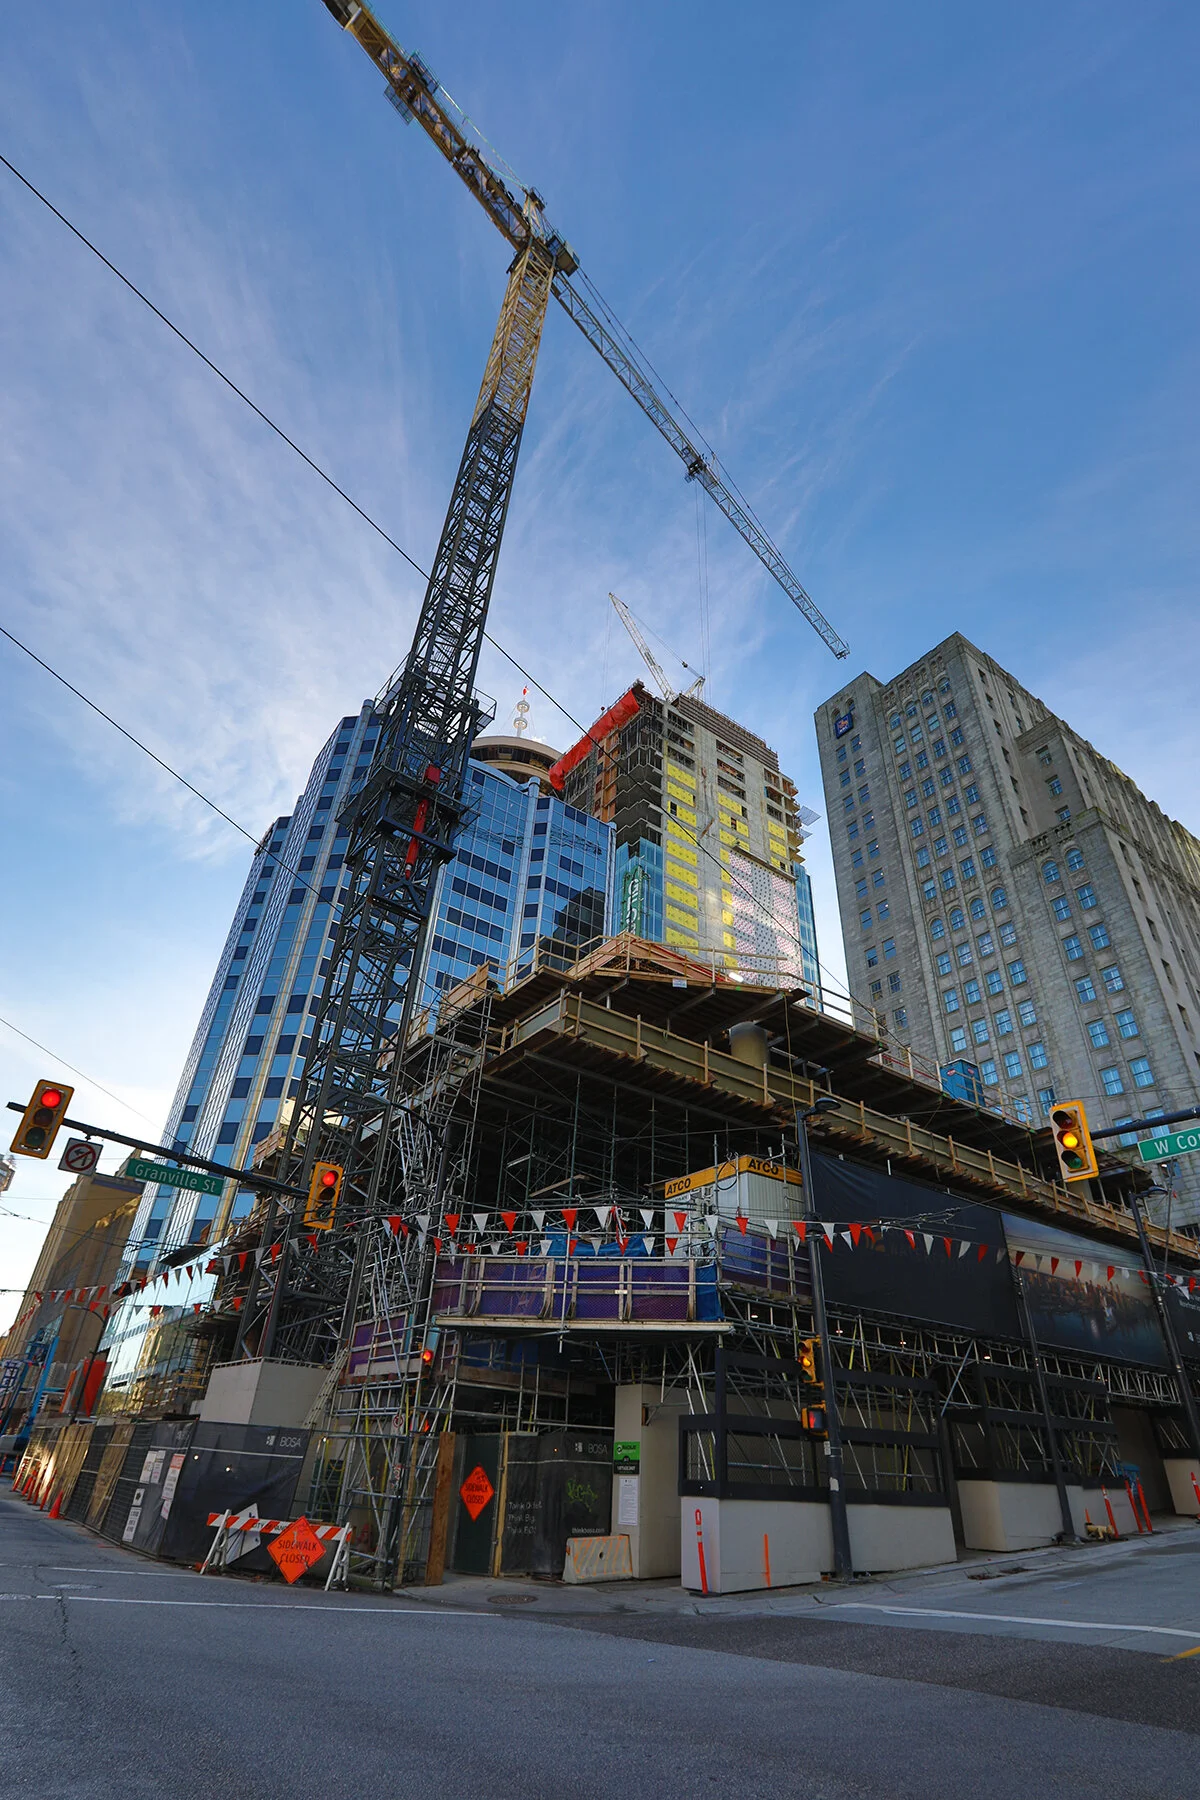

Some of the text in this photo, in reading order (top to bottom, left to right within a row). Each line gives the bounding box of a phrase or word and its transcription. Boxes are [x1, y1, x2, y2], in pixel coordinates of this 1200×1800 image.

[1154, 1135, 1200, 1155] W Co
[747, 1159, 779, 1176] ATCO
[135, 1164, 217, 1193] Granville St
[666, 1178, 691, 1195] ATCO
[280, 1436, 301, 1448] BOSA
[588, 1443, 608, 1454] BOSA
[466, 1494, 485, 1505] CLOSED
[277, 1540, 317, 1552] SIDEWALK
[280, 1553, 311, 1564] CLOSED
